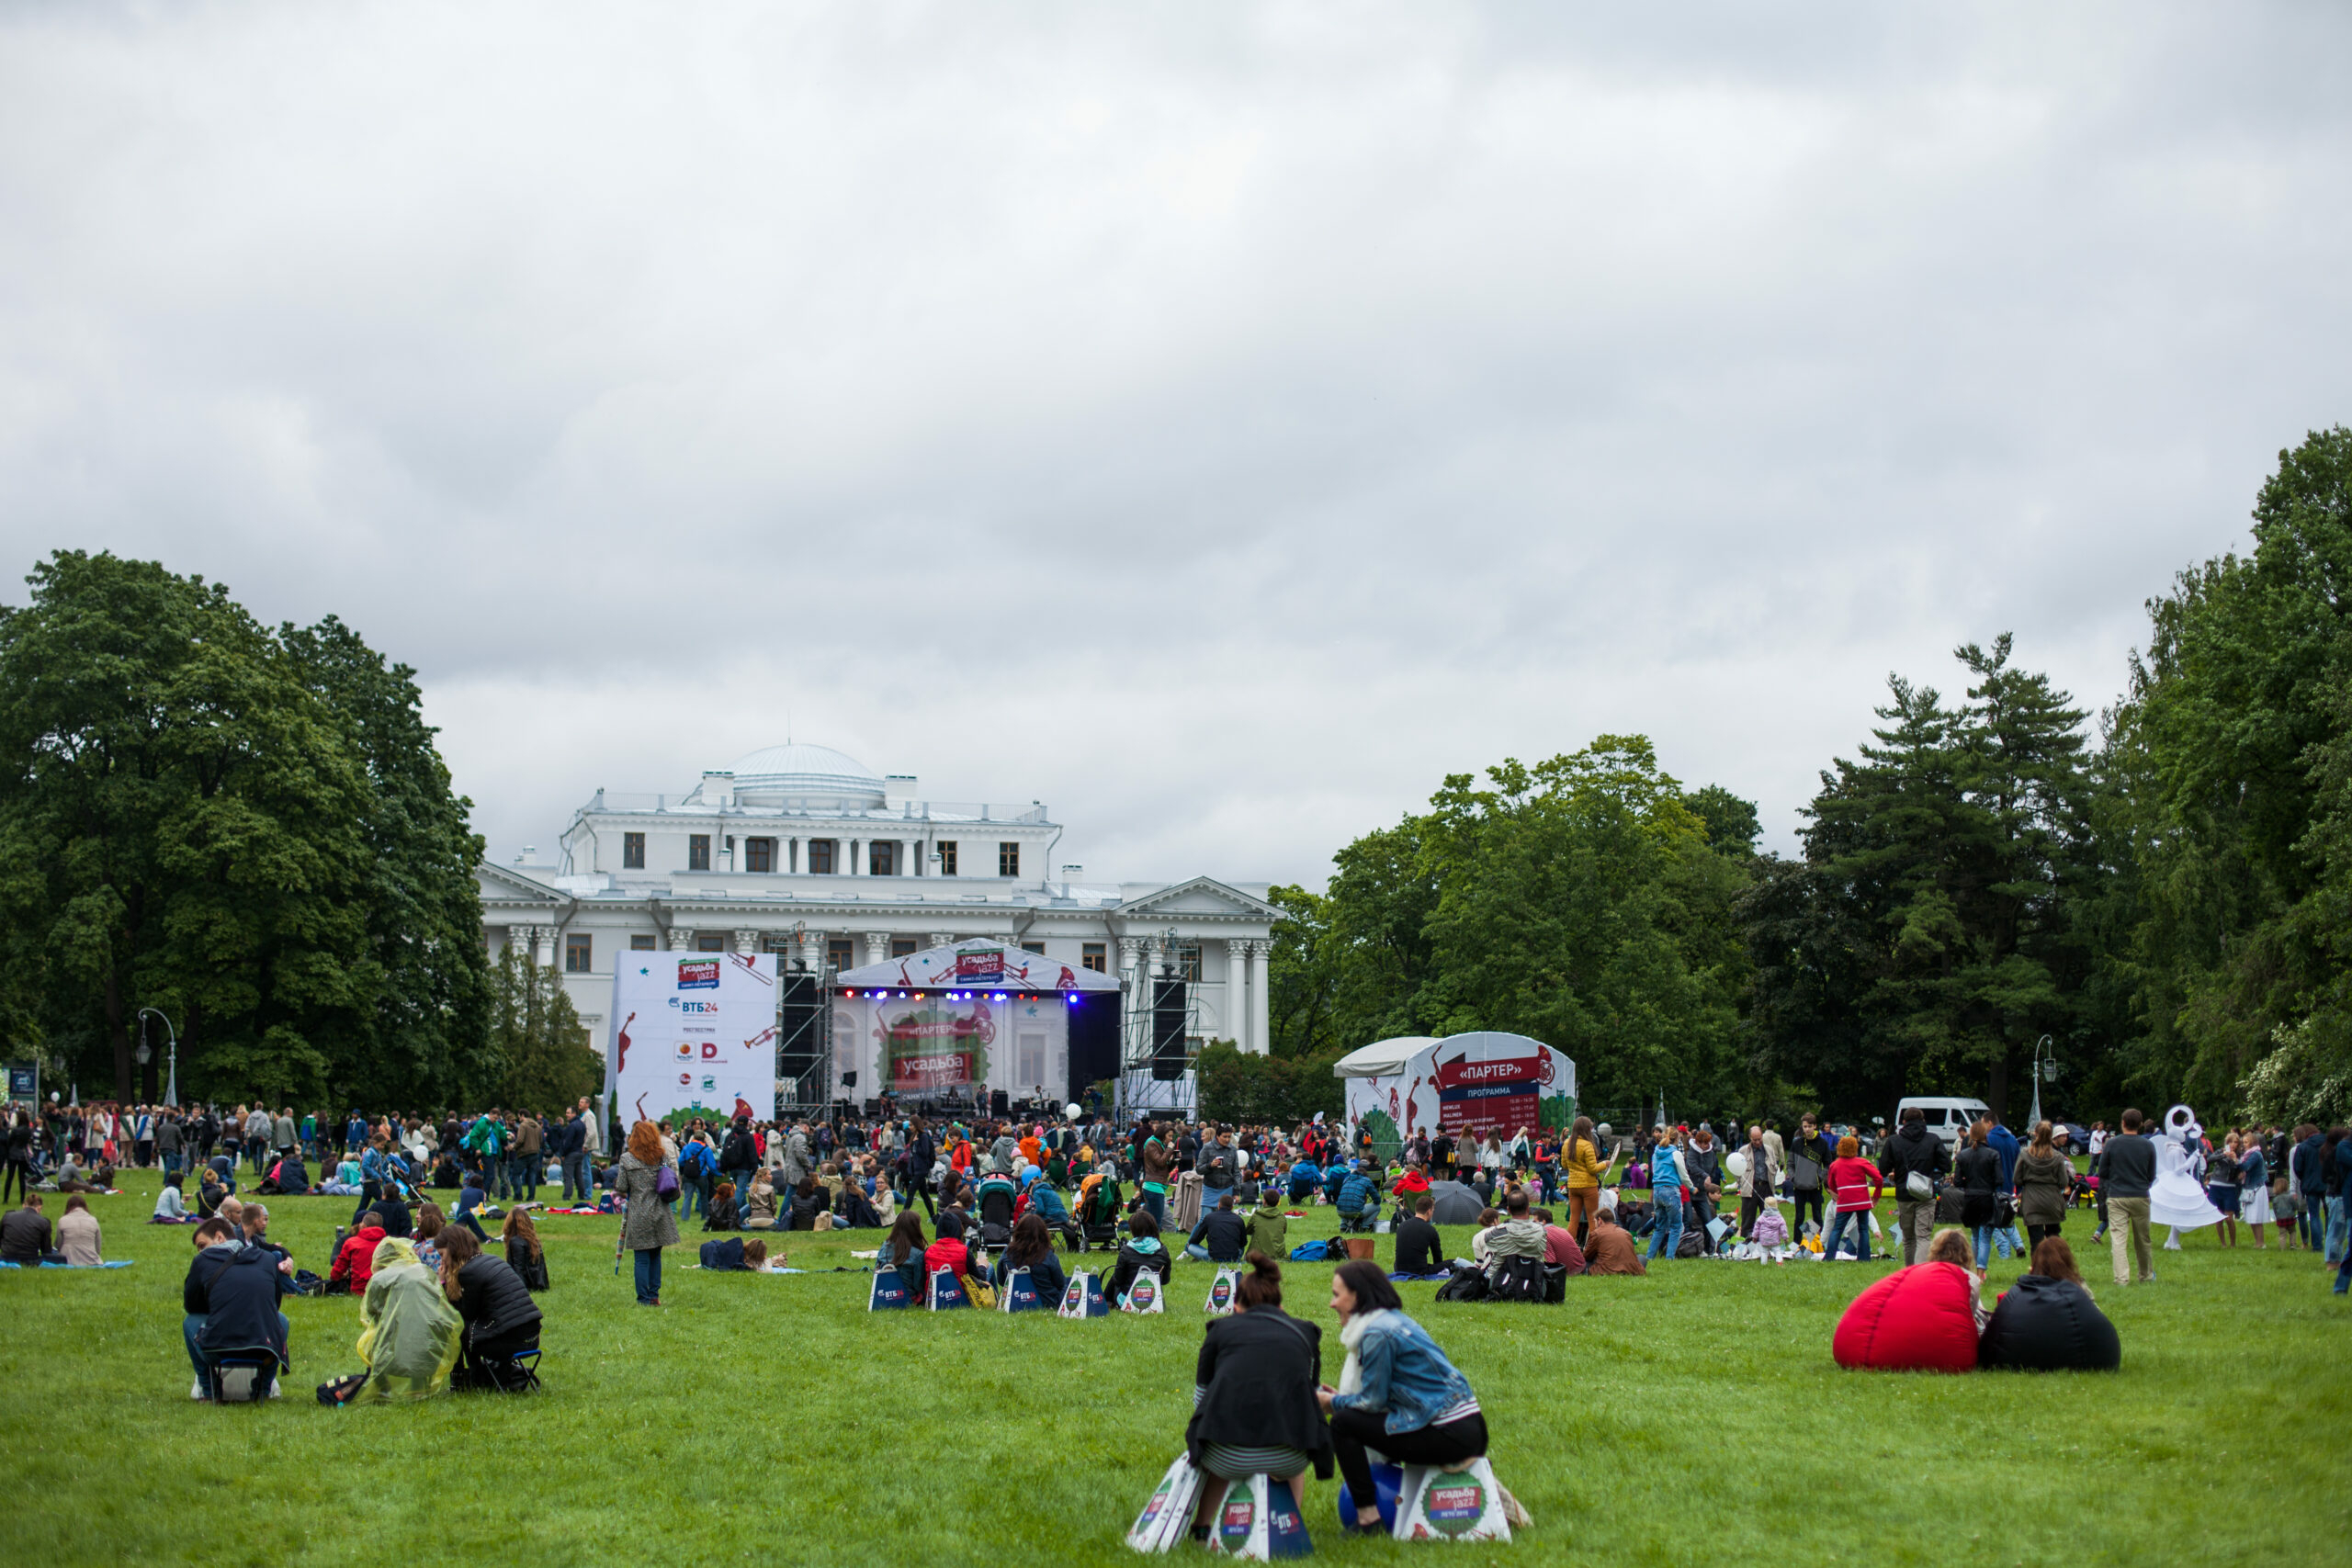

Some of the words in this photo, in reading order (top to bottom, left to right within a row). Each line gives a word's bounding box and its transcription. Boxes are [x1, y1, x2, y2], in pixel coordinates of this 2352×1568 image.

[961, 953, 998, 966] усадьба
[683, 963, 715, 974] усадьба
[978, 963, 999, 976] jazz
[697, 970, 715, 982] jazz
[683, 1002, 718, 1012] ВТБ24
[903, 1054, 963, 1075] усадьба
[1459, 1064, 1522, 1079] «ПАРТЕР»
[932, 1069, 964, 1091] jazz
[1468, 1087, 1511, 1097] ПРОГРАММА
[885, 1289, 904, 1298] ВТБ24
[945, 1289, 961, 1298] ВТБ24
[1020, 1292, 1036, 1300] ВТБ24
[1436, 1488, 1475, 1501] усадьба
[1229, 1503, 1250, 1517] усадьба
[1453, 1498, 1475, 1511] jazz
[1237, 1514, 1249, 1526] jazz
[1277, 1512, 1299, 1529] ВТБ24
